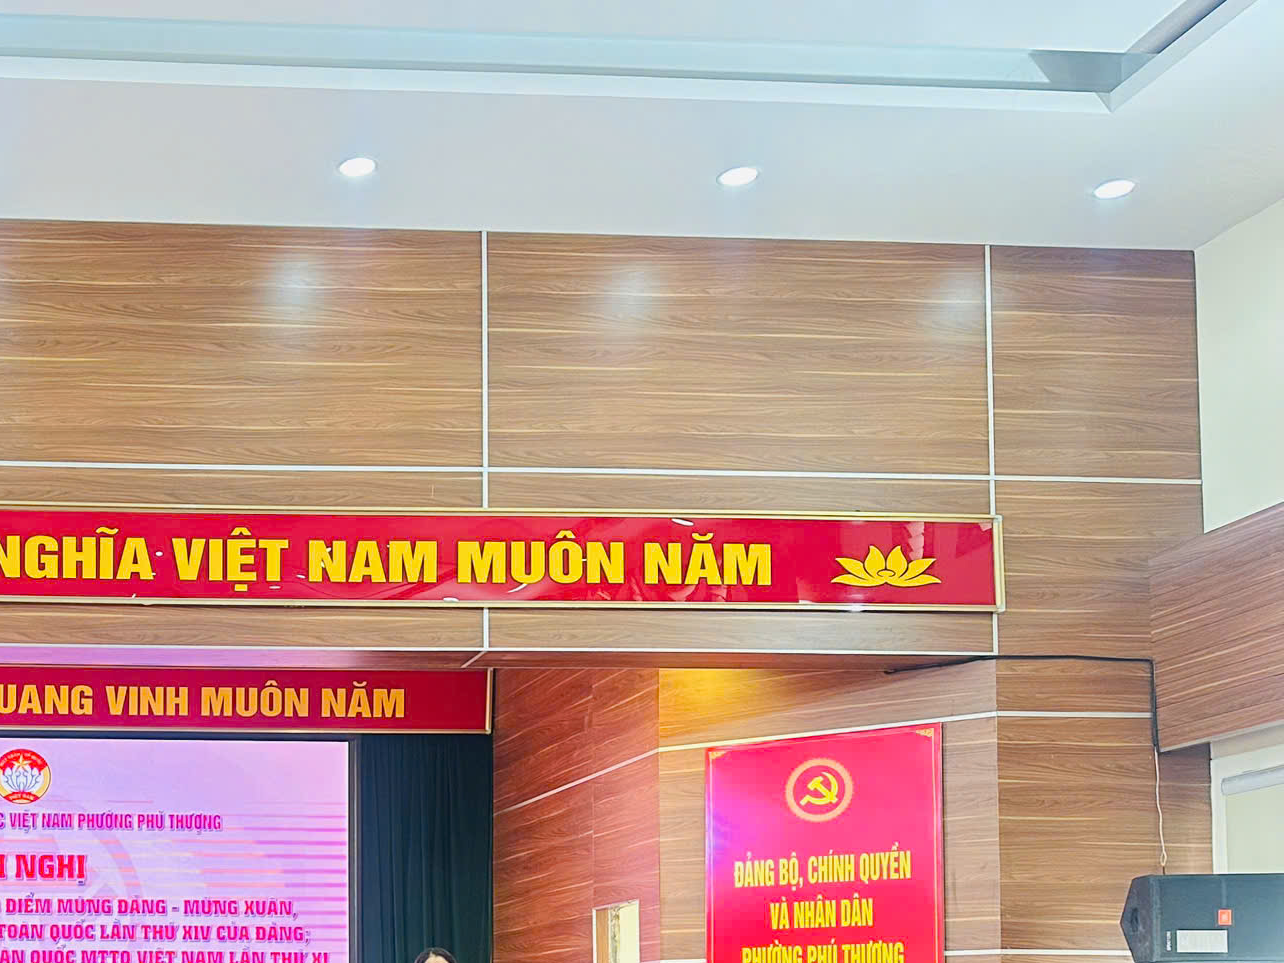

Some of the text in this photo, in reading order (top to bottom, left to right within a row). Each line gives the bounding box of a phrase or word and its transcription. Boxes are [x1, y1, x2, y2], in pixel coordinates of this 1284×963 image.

[172, 524, 288, 592] VIỆT
[308, 539, 438, 583] NAM
[457, 530, 625, 585] MUÔN
[644, 530, 772, 587] NĂM
[105, 686, 189, 717] VINH
[201, 680, 309, 718] MUÔN
[321, 680, 405, 719] NĂM
[9, 810, 38, 833] VIỆT
[41, 812, 73, 829] NAM
[78, 810, 133, 829] PHƯỜNG
[137, 811, 164, 829] PHÚ
[169, 814, 222, 834] THƯỢNG
[15, 854, 86, 884] NGHỊ
[734, 852, 775, 889] ĐẢNG
[779, 852, 804, 892] BỘ,
[808, 849, 855, 885] CHÍNH
[770, 893, 874, 931] VÀ NHÂN DÂN
